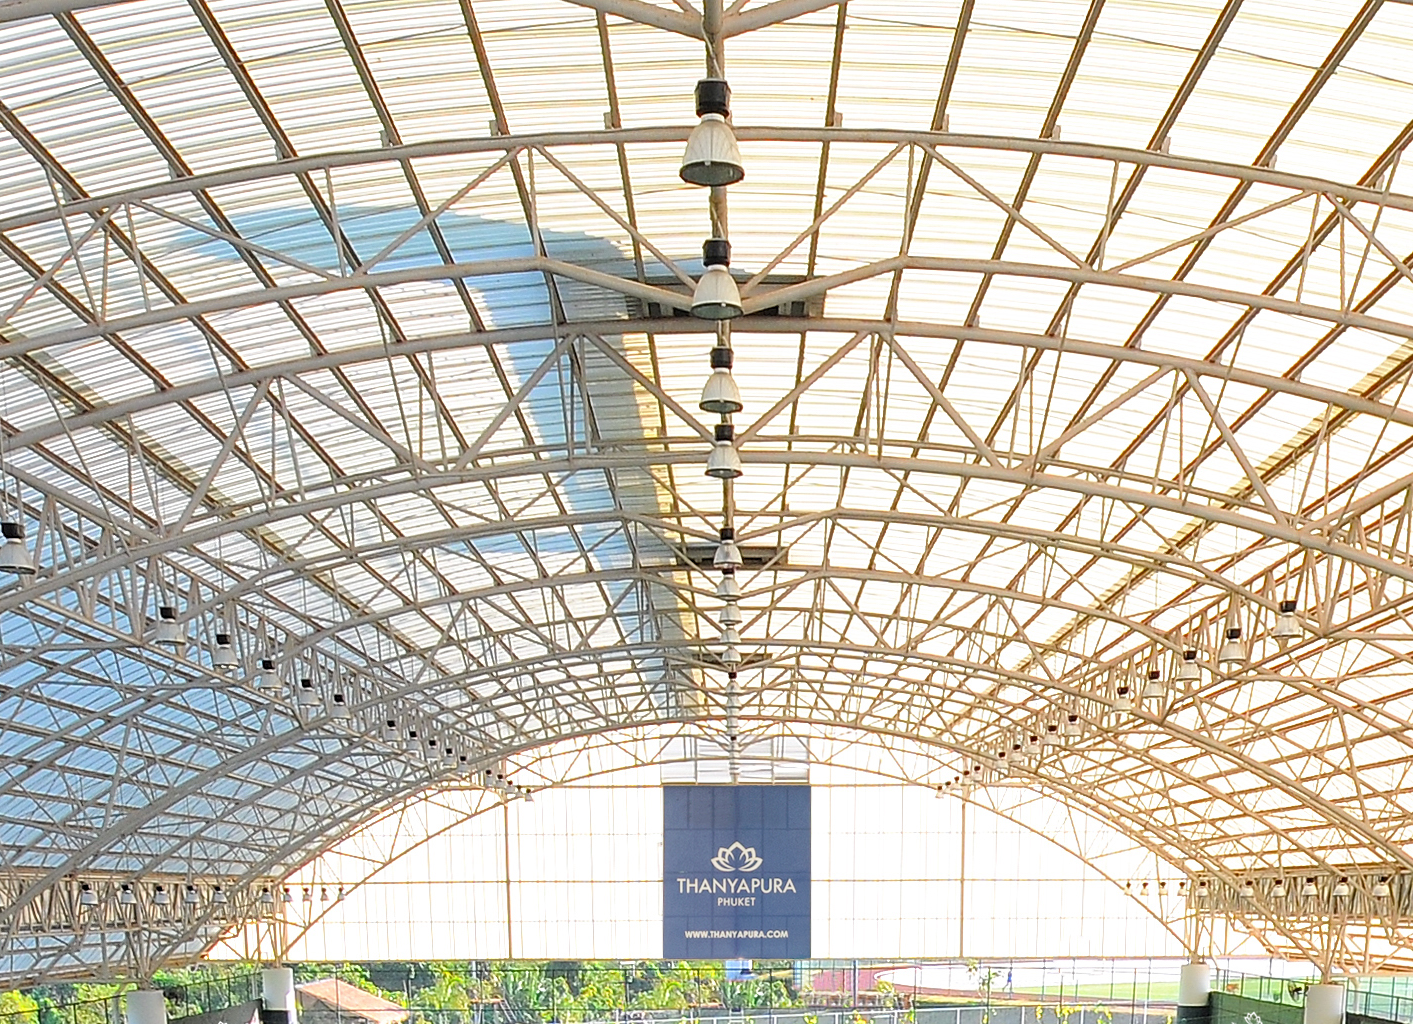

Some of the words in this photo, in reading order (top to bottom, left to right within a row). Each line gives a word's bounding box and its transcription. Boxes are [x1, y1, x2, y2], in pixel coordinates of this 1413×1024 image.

[676, 878, 797, 894] THANYAPURA
[717, 897, 756, 907] PHUKET
[684, 930, 789, 939] WWW.THANYAPURA.COM
